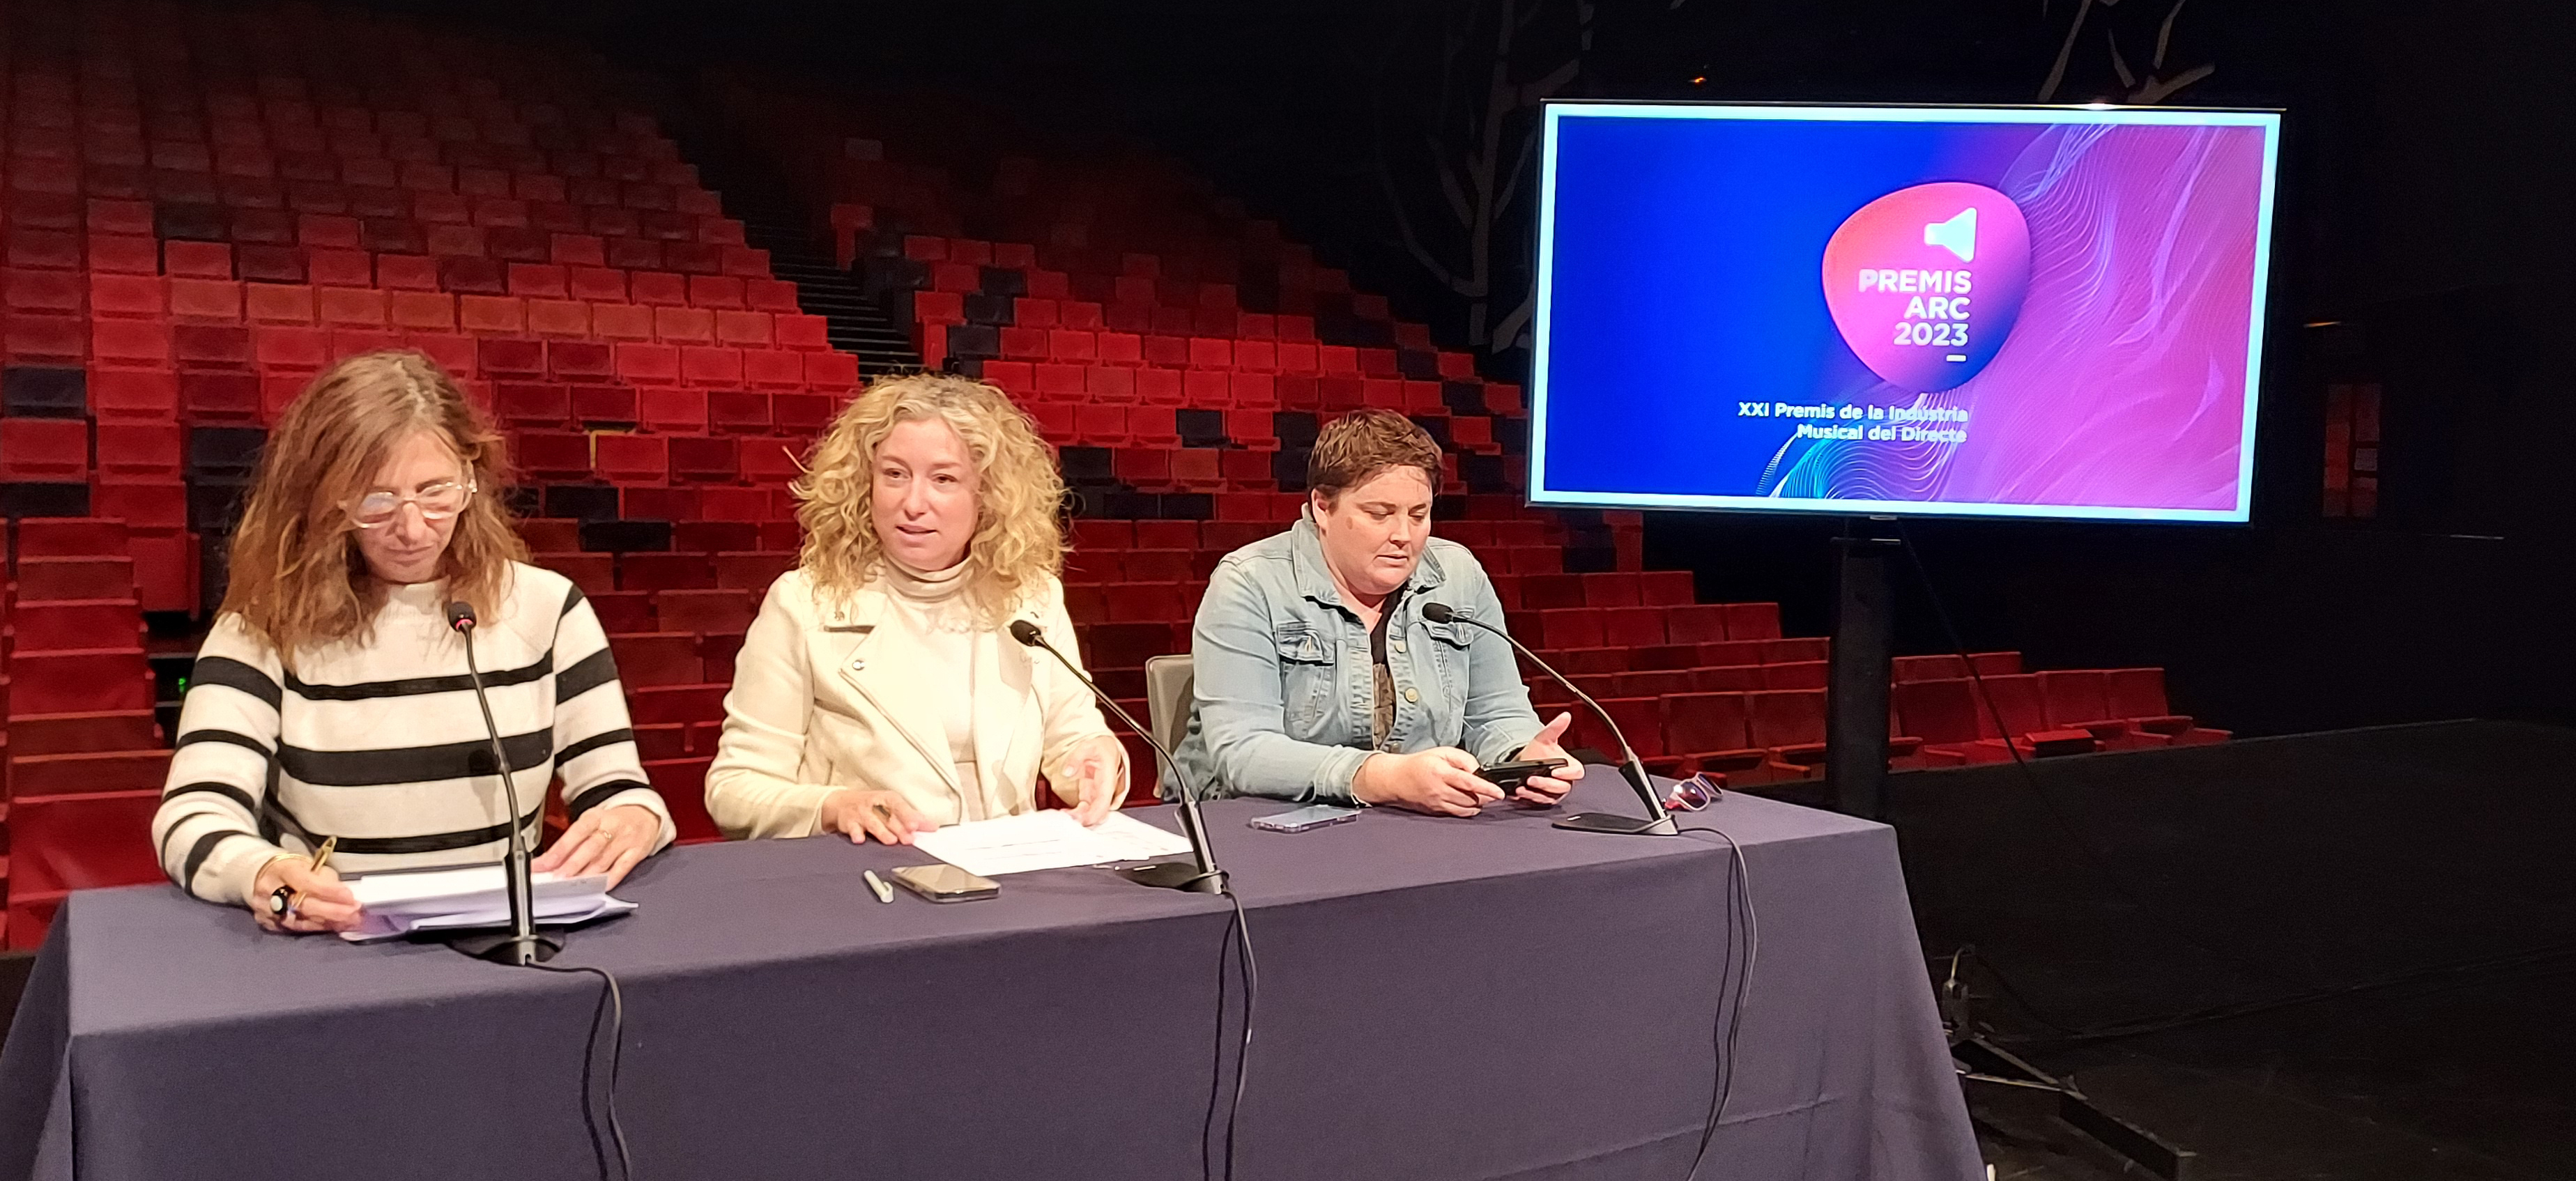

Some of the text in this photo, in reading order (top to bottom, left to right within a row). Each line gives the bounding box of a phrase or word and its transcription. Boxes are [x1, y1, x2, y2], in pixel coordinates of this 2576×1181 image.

[1858, 268, 1972, 294] PREMIS
[1903, 295, 1972, 321] ARC
[1893, 322, 1969, 346] 2023
[1738, 401, 1770, 417] XXI
[1774, 402, 1836, 419] Premis
[1839, 403, 1864, 419] de
[1868, 404, 1885, 420] la
[1797, 423, 1968, 442] Musical del Directe
